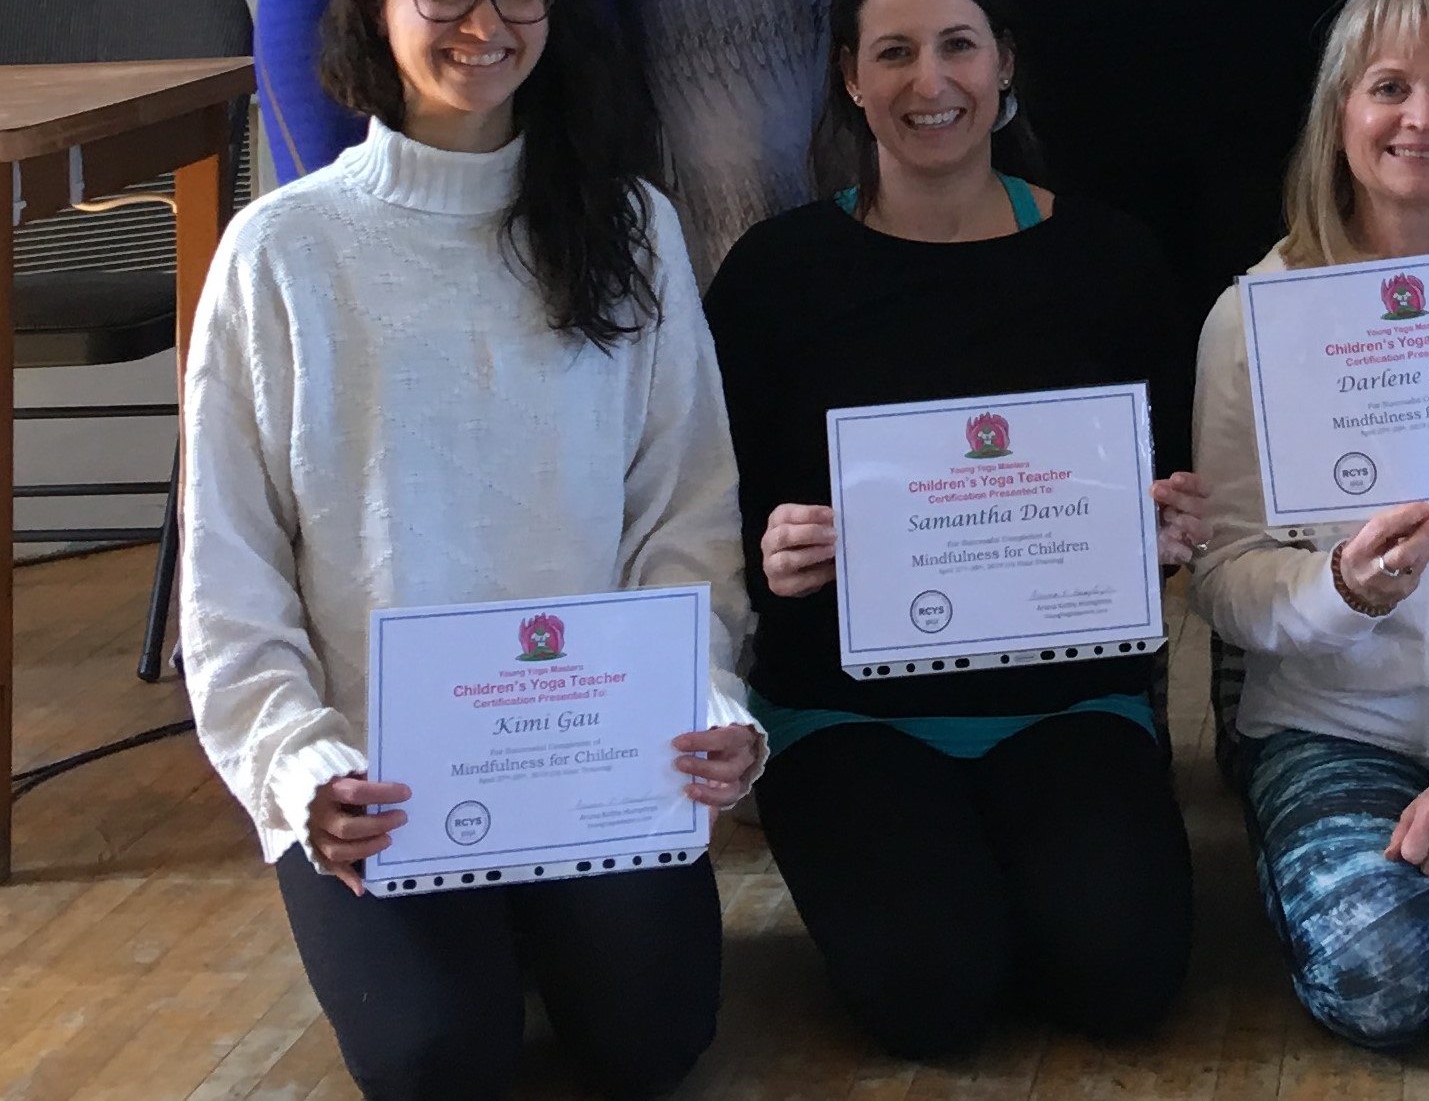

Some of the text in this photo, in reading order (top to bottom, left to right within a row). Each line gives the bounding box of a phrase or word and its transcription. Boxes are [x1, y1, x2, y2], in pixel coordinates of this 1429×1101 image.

[1325, 339, 1395, 356] Children's
[1345, 353, 1405, 367] Certification
[1337, 368, 1421, 393] Darlene
[1332, 411, 1422, 429] Mindfulness
[908, 469, 1072, 493] Children's Yoga Teacher
[1342, 467, 1369, 478] RCYS
[928, 492, 987, 504] Certification
[989, 486, 1038, 498] Presented
[908, 497, 1089, 532] Samantha Davoli
[912, 550, 1000, 567] Mindfulness
[1004, 545, 1024, 558] for
[1028, 540, 1090, 556] Children
[918, 606, 945, 616] RCYS
[453, 672, 627, 697] Children's Yoga Teacher
[473, 696, 536, 709] Certification
[538, 690, 590, 703] Presented
[492, 711, 600, 735] Kimi Gau
[451, 758, 545, 777] Mindfulness
[549, 753, 570, 767] for
[574, 747, 639, 764] Children
[454, 816, 482, 827] RCYS
